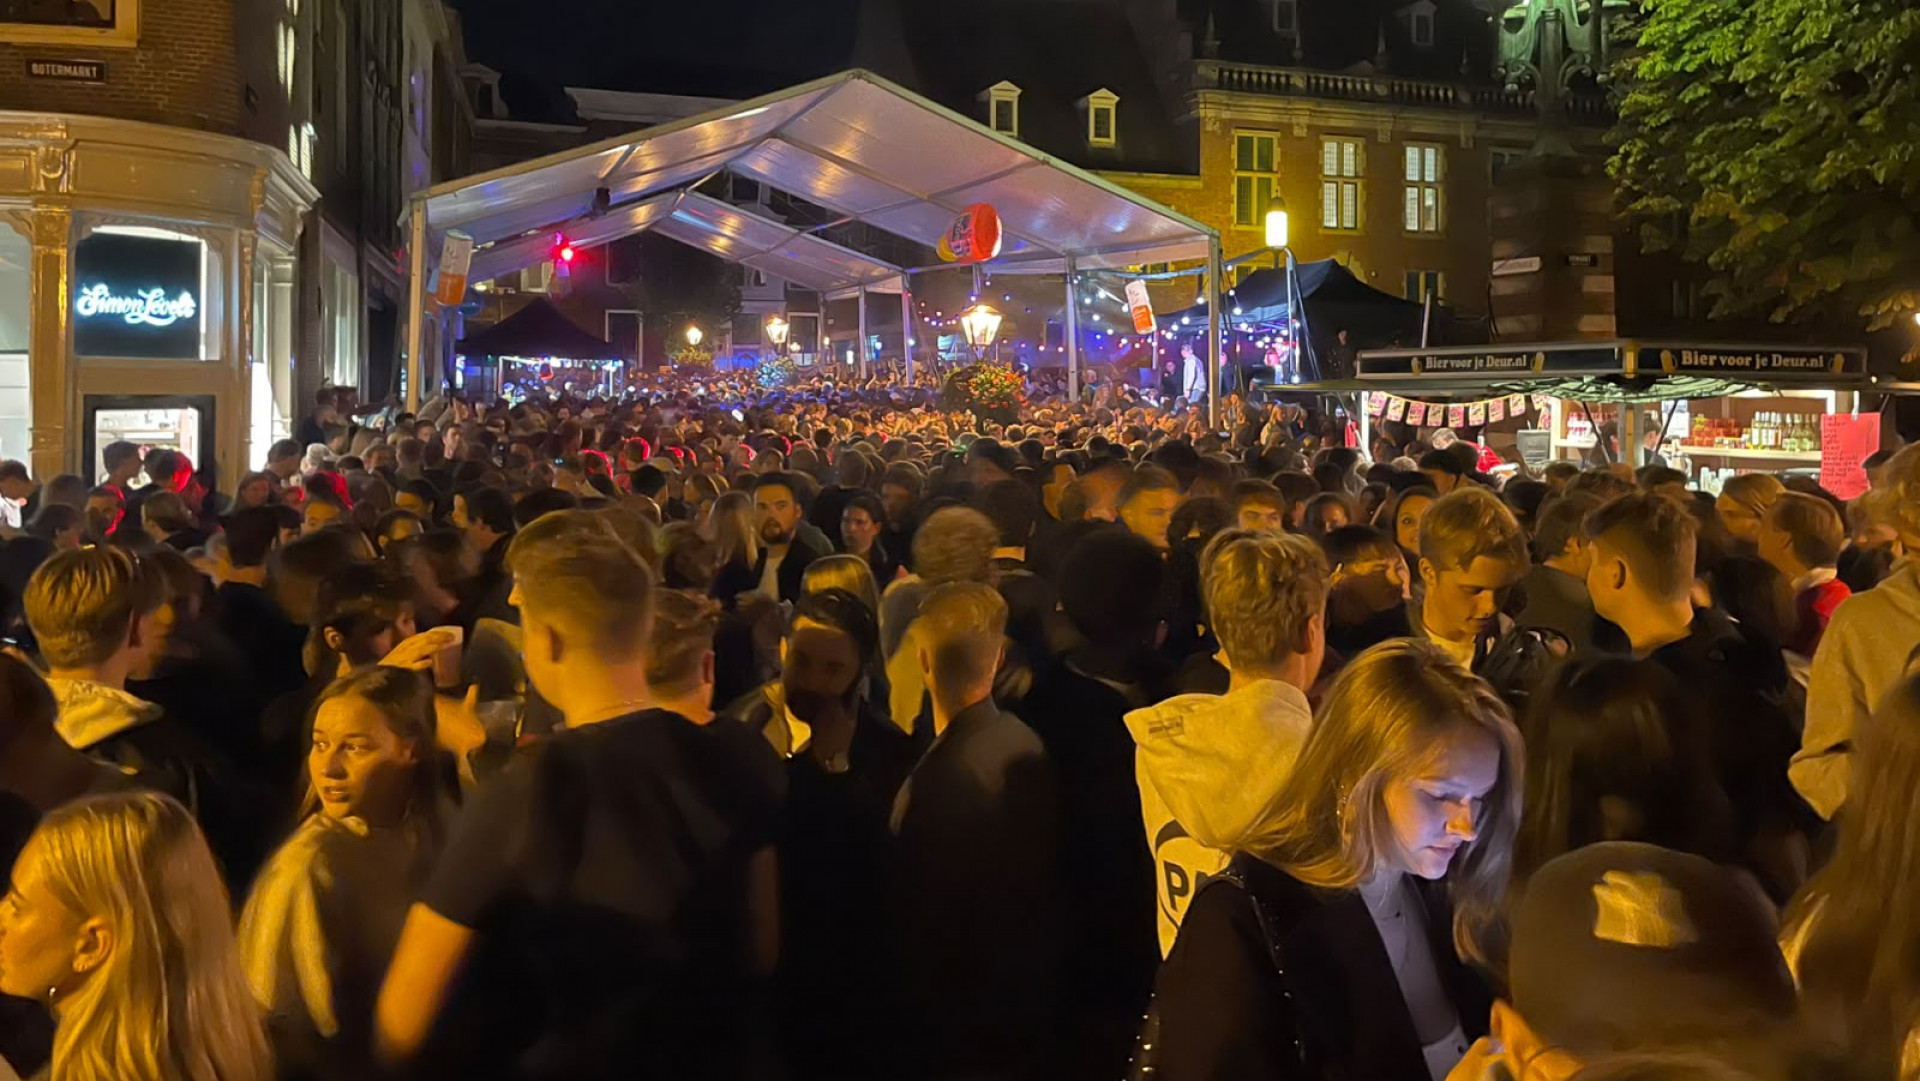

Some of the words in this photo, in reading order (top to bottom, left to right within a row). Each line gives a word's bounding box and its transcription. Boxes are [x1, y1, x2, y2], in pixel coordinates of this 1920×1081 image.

[77, 283, 145, 316] Simon
[1425, 356, 1448, 369] Bier
[1449, 359, 1472, 368] voor
[1474, 356, 1483, 370] je
[1486, 354, 1527, 367] Deur.nl
[1681, 350, 1717, 366] Bier
[1718, 356, 1752, 366] voor
[1755, 354, 1768, 369] je
[1771, 354, 1824, 368] Deur.nl
